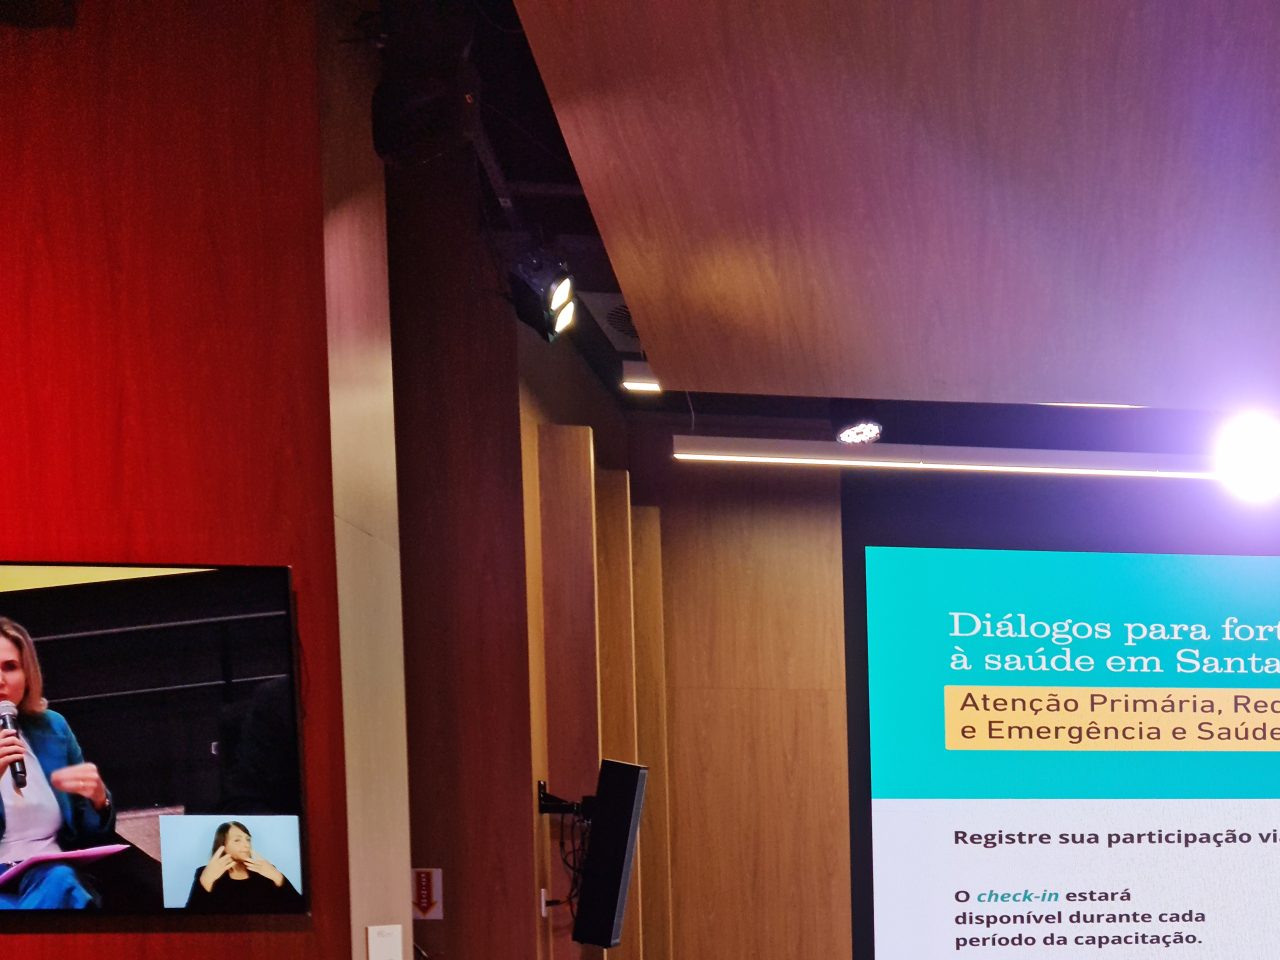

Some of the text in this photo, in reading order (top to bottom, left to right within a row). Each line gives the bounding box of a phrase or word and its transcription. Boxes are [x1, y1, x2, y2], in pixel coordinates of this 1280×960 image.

[948, 612, 1111, 644] Diálogos
[1124, 621, 1210, 646] para
[950, 646, 972, 671] à
[985, 647, 1095, 672] saúde
[1106, 655, 1164, 673] em
[960, 692, 1079, 715] Atenção
[1090, 694, 1222, 716] Primária,
[961, 725, 976, 739] e
[988, 720, 1161, 744] Emergência
[1172, 726, 1187, 740] e
[954, 830, 1051, 848] Registre
[1058, 833, 1099, 844] sua
[1107, 829, 1252, 848] participação
[954, 888, 1131, 903] O check-in estará
[954, 910, 1206, 928] disponível durante cada
[955, 931, 1202, 951] período da capacitação.
